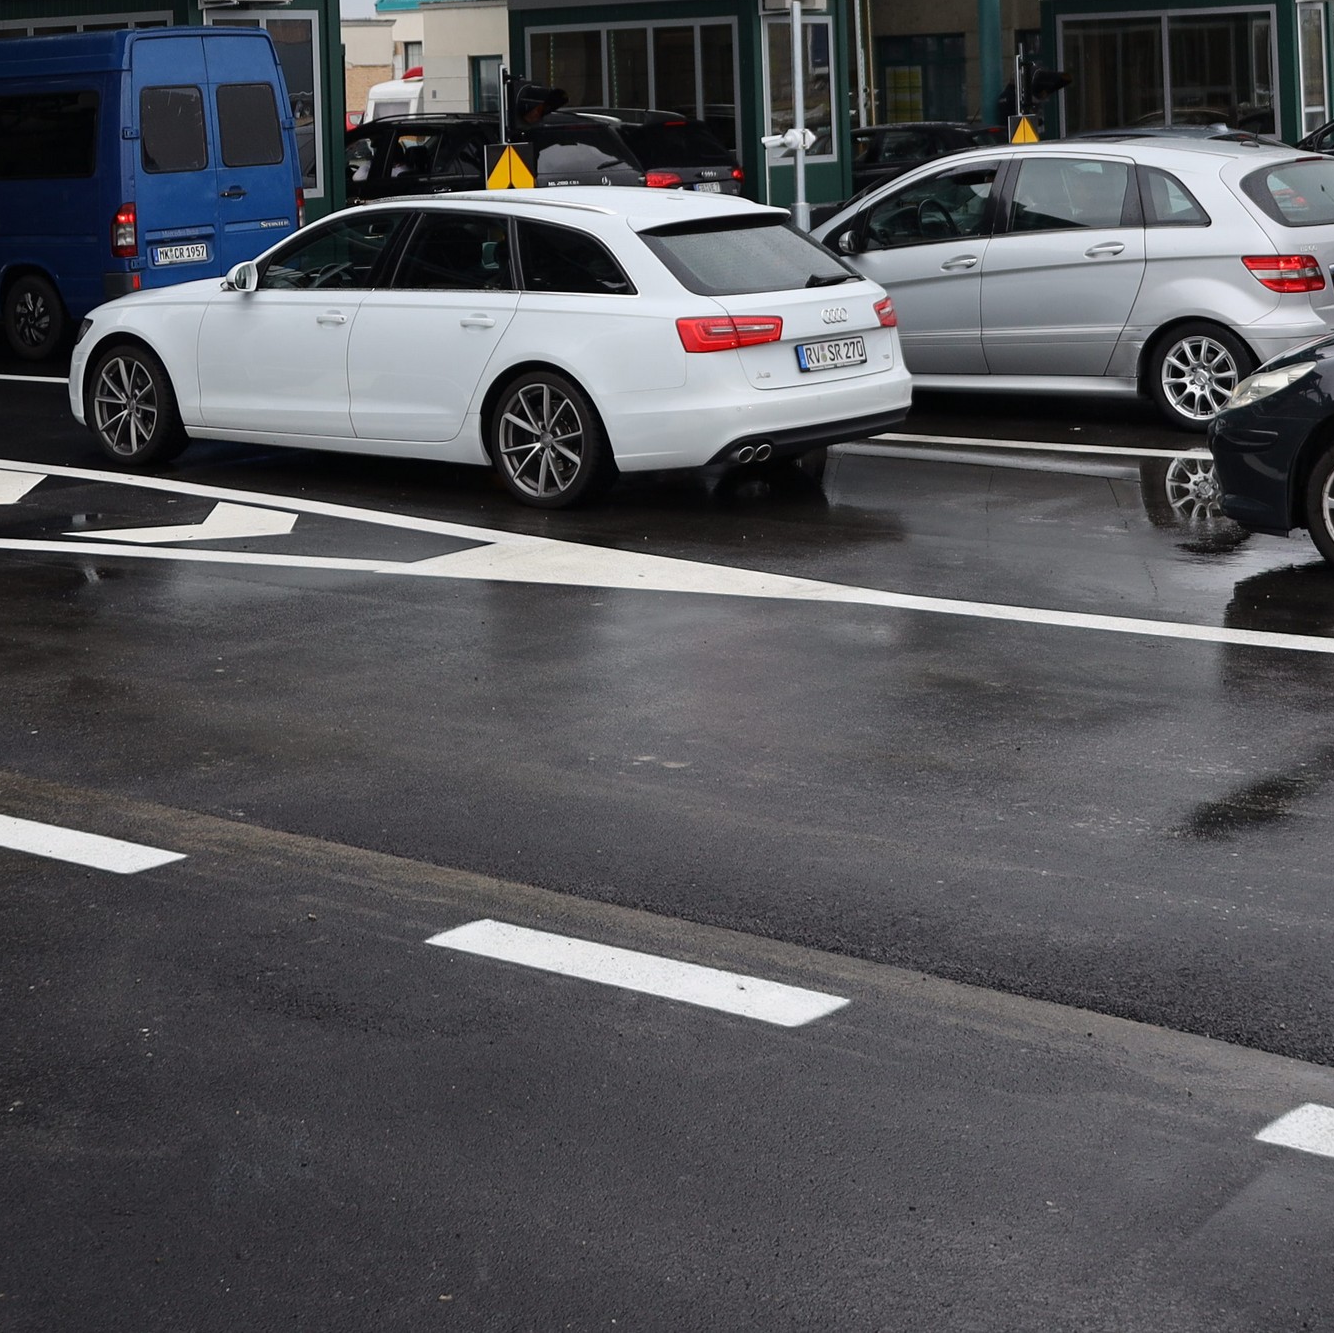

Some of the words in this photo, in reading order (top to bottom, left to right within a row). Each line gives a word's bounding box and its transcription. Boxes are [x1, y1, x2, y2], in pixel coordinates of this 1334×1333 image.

[159, 249, 170, 260] MK
[174, 248, 185, 259] CR
[186, 245, 205, 258] 1957
[805, 346, 820, 365] RV
[827, 343, 843, 362] SR
[843, 340, 863, 359] 270
